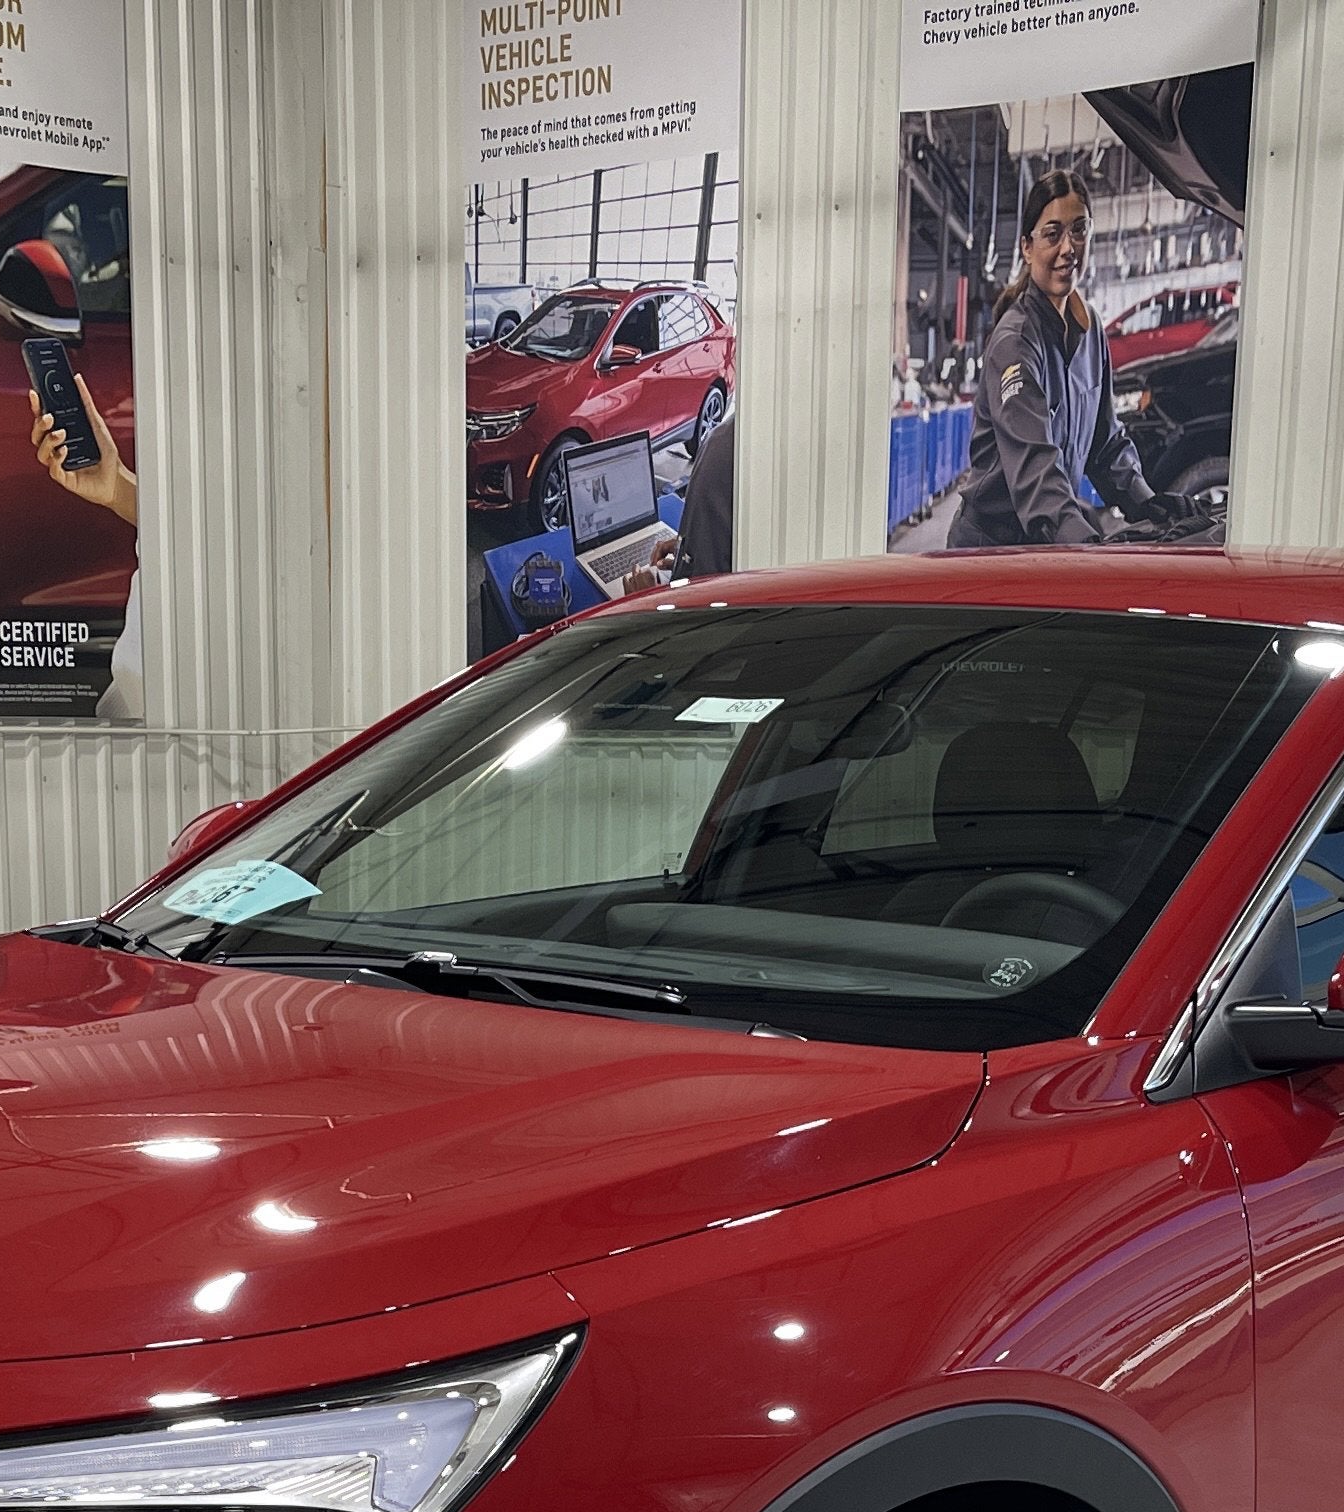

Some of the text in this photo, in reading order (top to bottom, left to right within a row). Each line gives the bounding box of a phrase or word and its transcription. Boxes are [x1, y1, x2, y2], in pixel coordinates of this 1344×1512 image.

[480, 0, 623, 38] MULTI-POINT
[923, 7, 972, 24] Factory
[975, 0, 1020, 18] trained
[923, 28, 961, 45] Chevy
[963, 20, 1007, 41] vehicle
[1011, 15, 1052, 33] better
[1055, 10, 1083, 26] than
[1088, 1, 1140, 22] anyone.
[480, 33, 572, 74] VEHICLE
[480, 64, 613, 110] INSPECTION
[21, 109, 50, 131] enjoy
[54, 114, 94, 131] remote
[45, 130, 80, 148] Mobile
[480, 100, 696, 142] The peace of mind that comes from getting
[480, 145, 502, 163] your
[504, 137, 546, 157] vehicle's
[548, 133, 580, 151] health
[582, 128, 624, 148] checked
[626, 124, 649, 140] with
[652, 126, 659, 137] a
[0, 620, 90, 643] CERTIFIED
[0, 645, 76, 668] SERVICE
